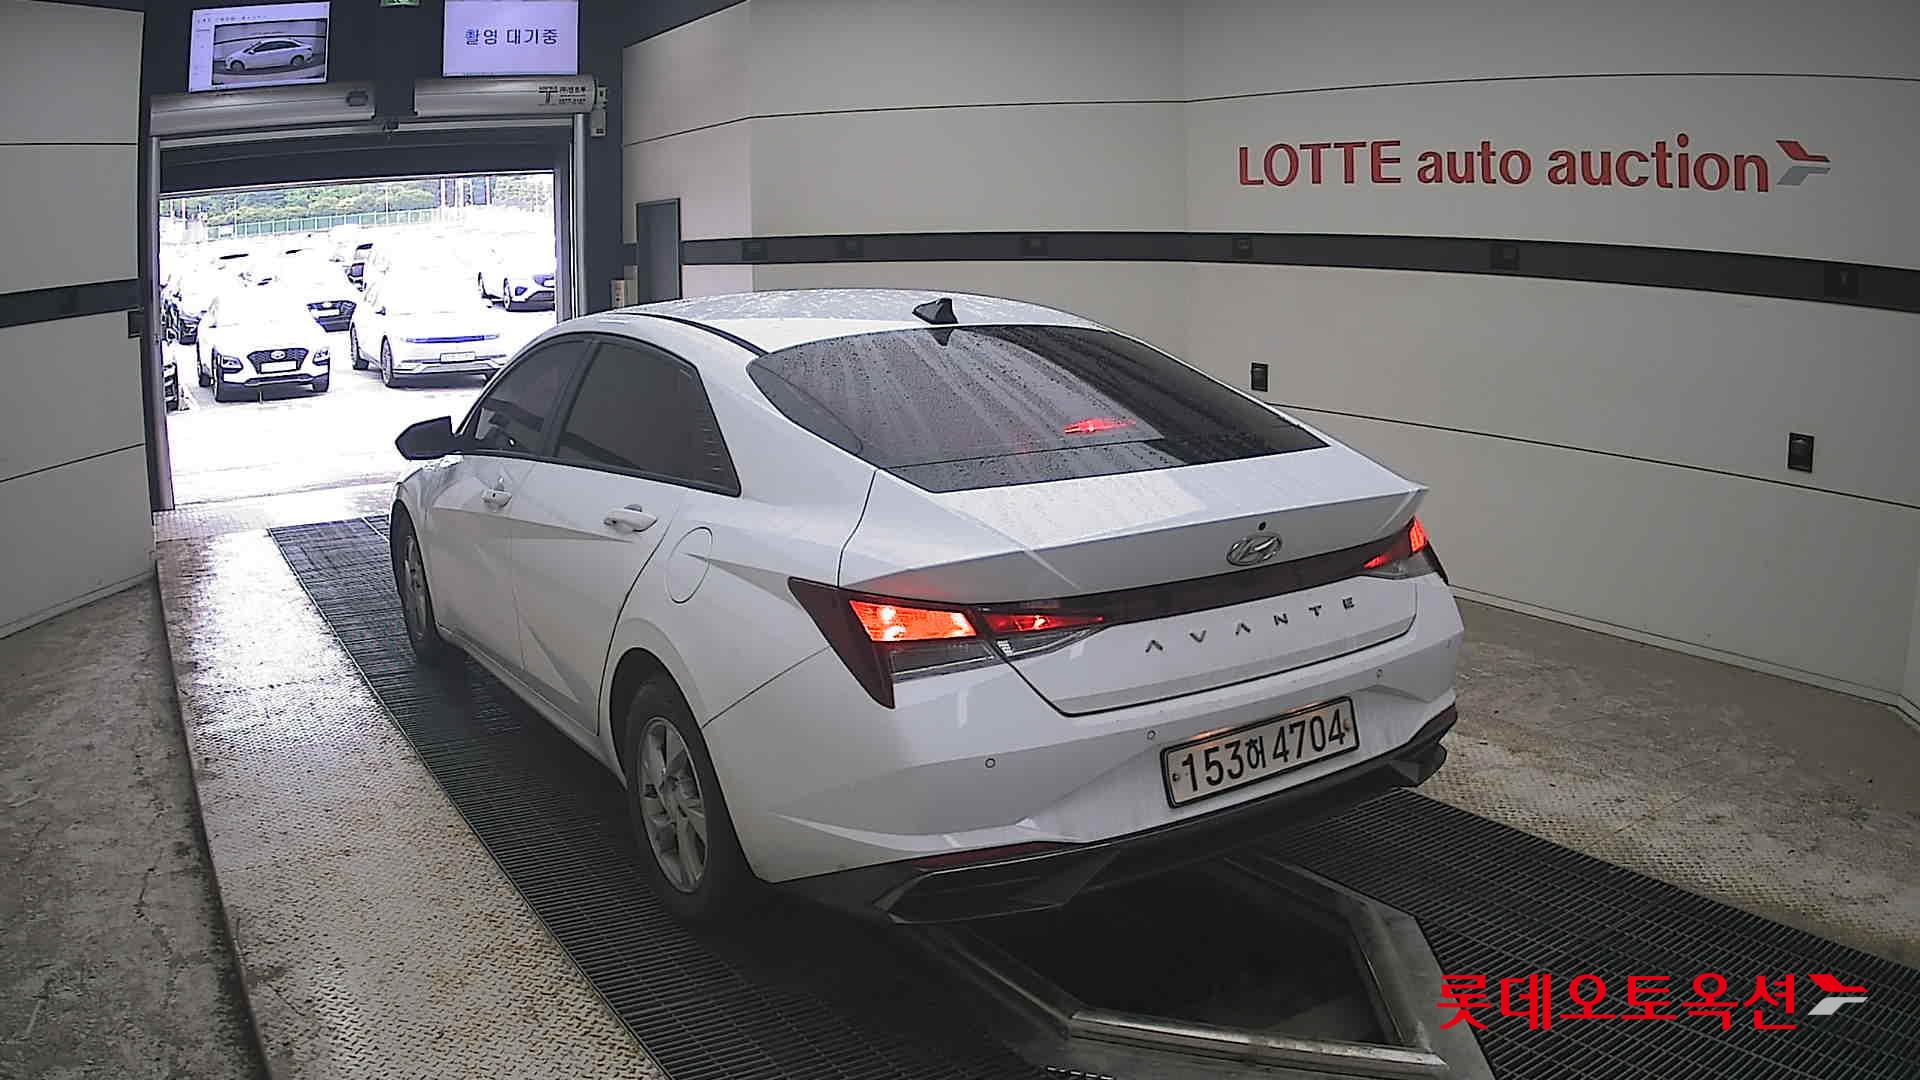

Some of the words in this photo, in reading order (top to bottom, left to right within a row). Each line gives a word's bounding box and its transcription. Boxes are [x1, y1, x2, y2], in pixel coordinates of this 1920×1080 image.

[506, 28, 558, 46] 대기중
[1238, 140, 1401, 187] LOTTE
[1416, 141, 1532, 185] auto
[1547, 133, 1769, 193] auction
[1145, 597, 1355, 653] AVANTE
